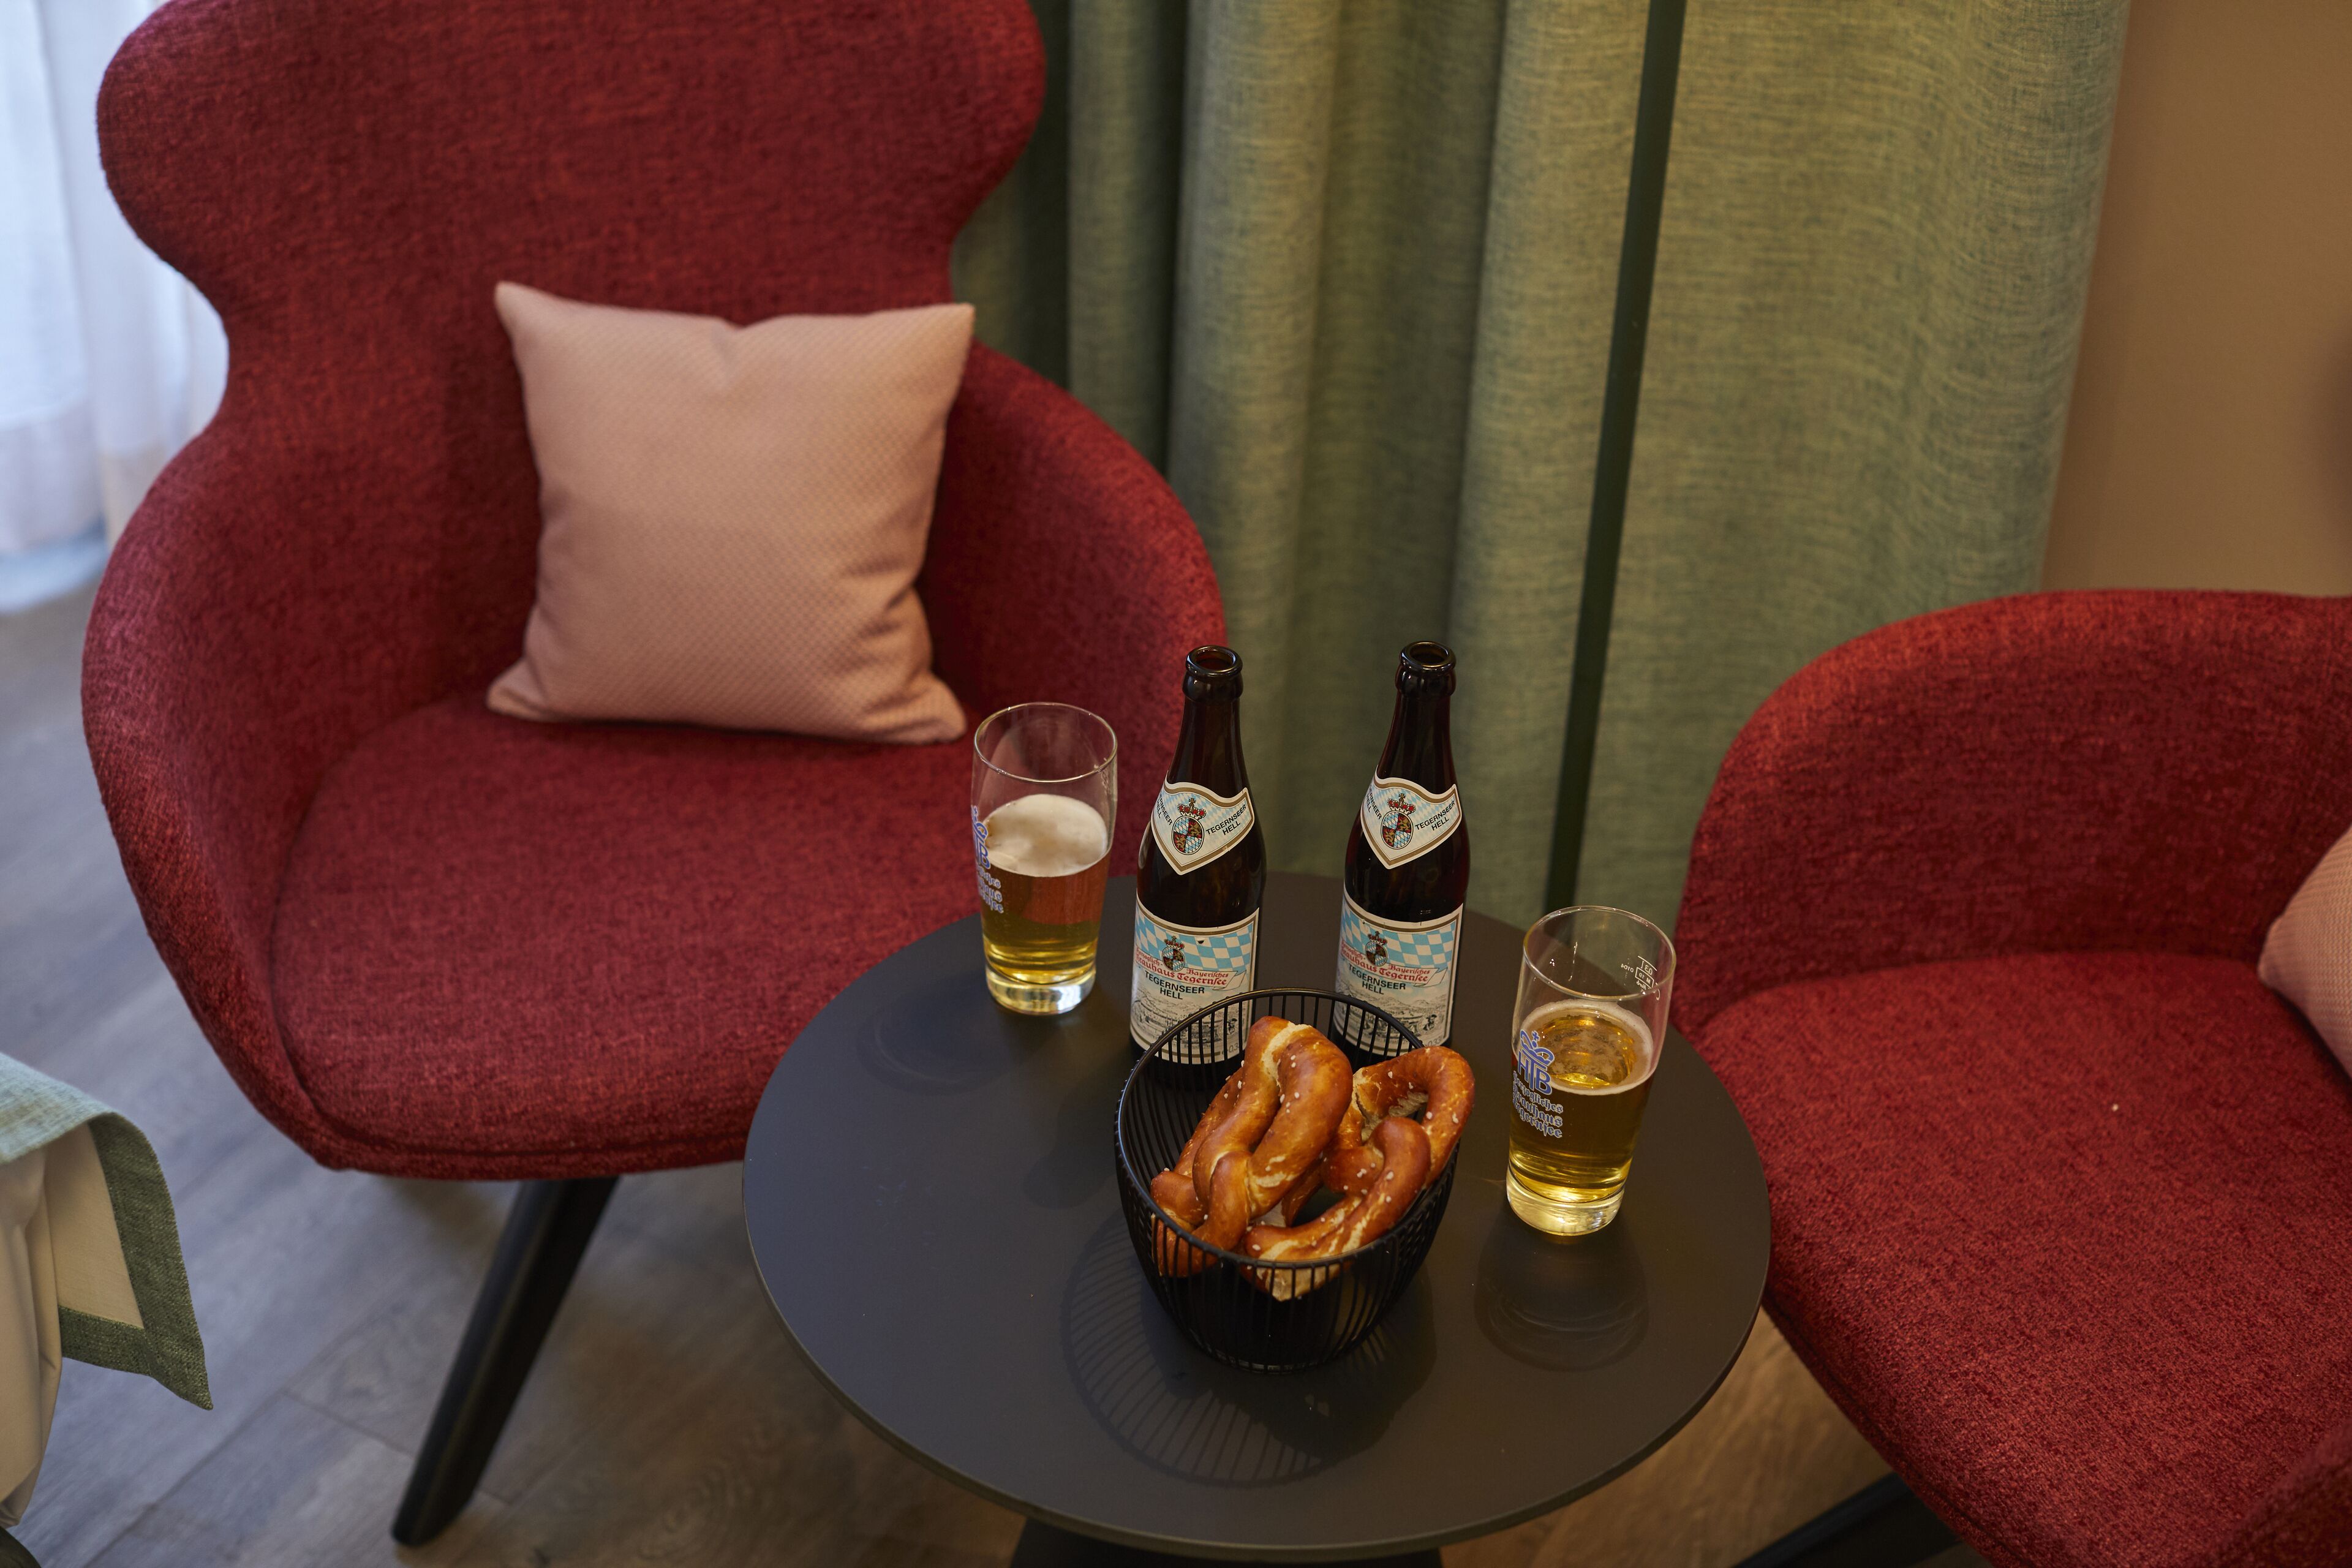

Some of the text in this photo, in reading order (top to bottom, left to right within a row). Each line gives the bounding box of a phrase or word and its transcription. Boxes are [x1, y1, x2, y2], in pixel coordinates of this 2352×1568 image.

[1206, 804, 1247, 835] TEGERNSEER
[1222, 821, 1241, 836] HELL
[1415, 801, 1455, 831] TEGERNSEER
[1432, 817, 1449, 831] HELL
[1145, 971, 1205, 994] TEGERNSEER
[1348, 965, 1406, 990] TEGERNSEER
[1362, 981, 1384, 995] HELL
[1159, 987, 1183, 1000] HELL
[1517, 1049, 1552, 1095] HTB
[1513, 1070, 1564, 1114] Herzogliches
[1513, 1082, 1563, 1128] Brauhaus
